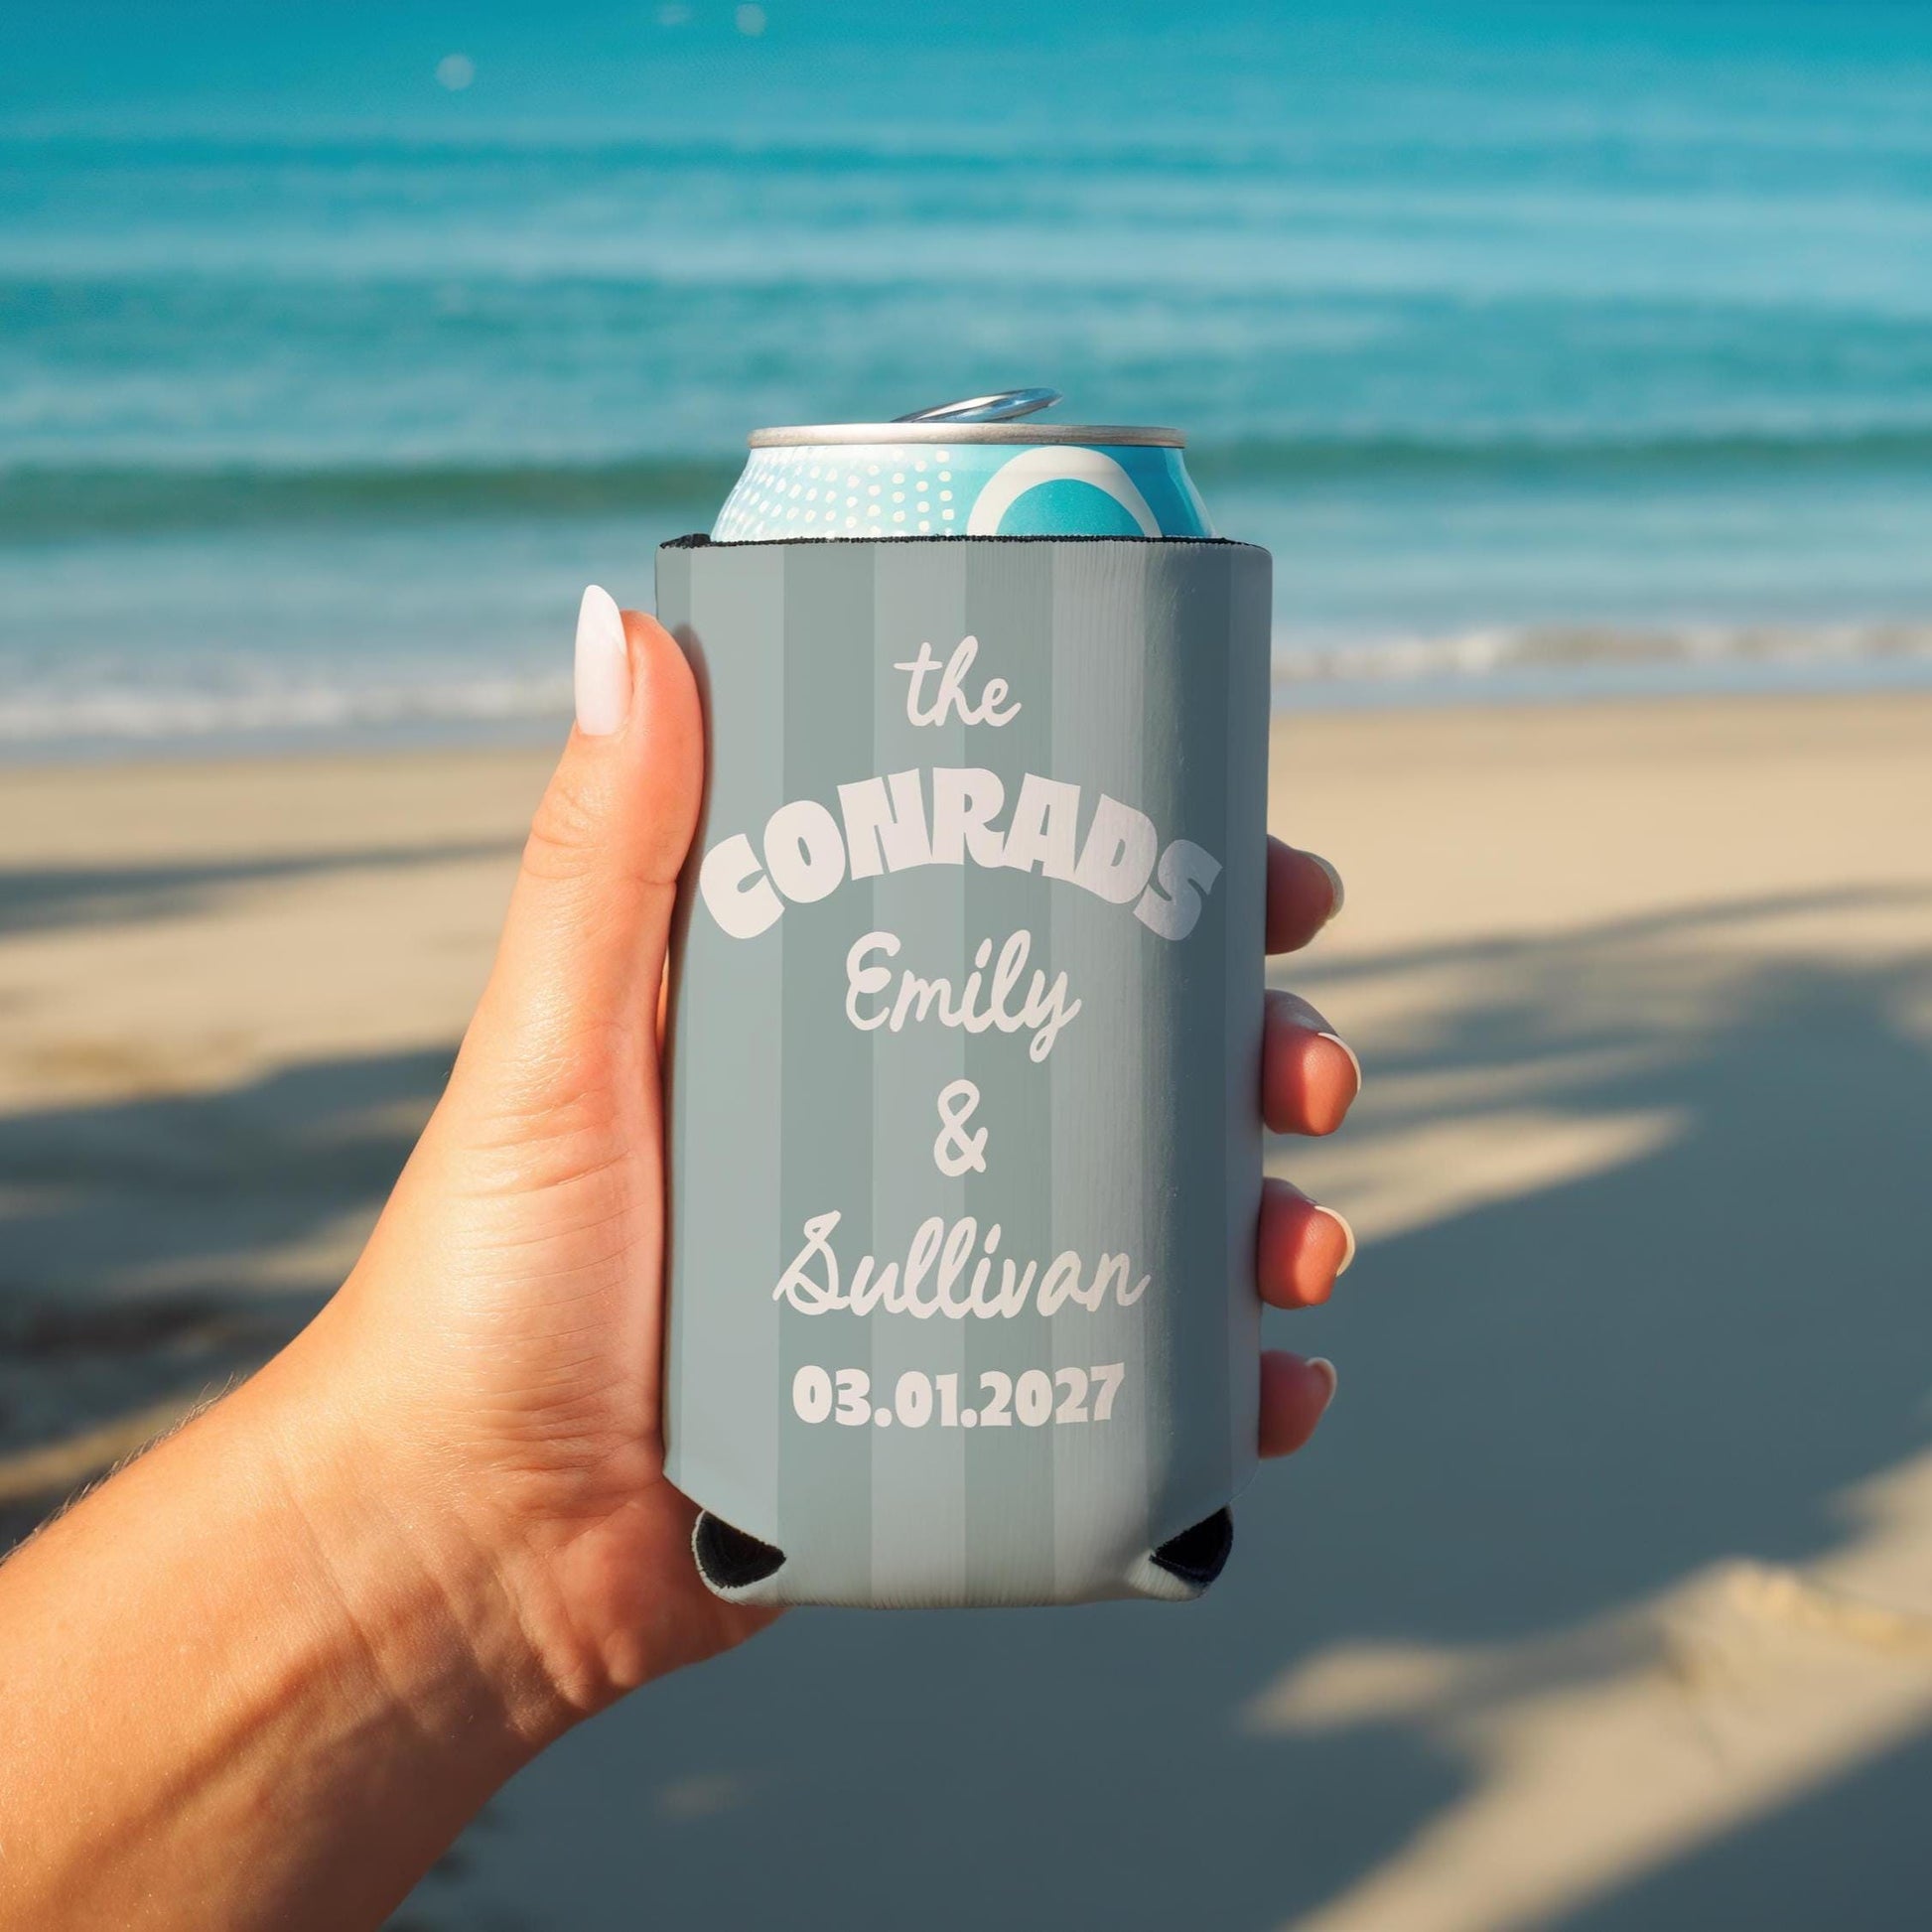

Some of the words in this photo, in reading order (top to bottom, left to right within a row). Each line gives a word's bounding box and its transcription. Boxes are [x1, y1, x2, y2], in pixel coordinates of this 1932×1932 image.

[894, 635, 1022, 729] the
[699, 767, 1223, 941] CONRADS
[845, 929, 1082, 1062] Emily
[933, 1079, 988, 1177] &
[772, 1209, 1151, 1319] Sullivan
[791, 1362, 1126, 1428] 03.01.2027
